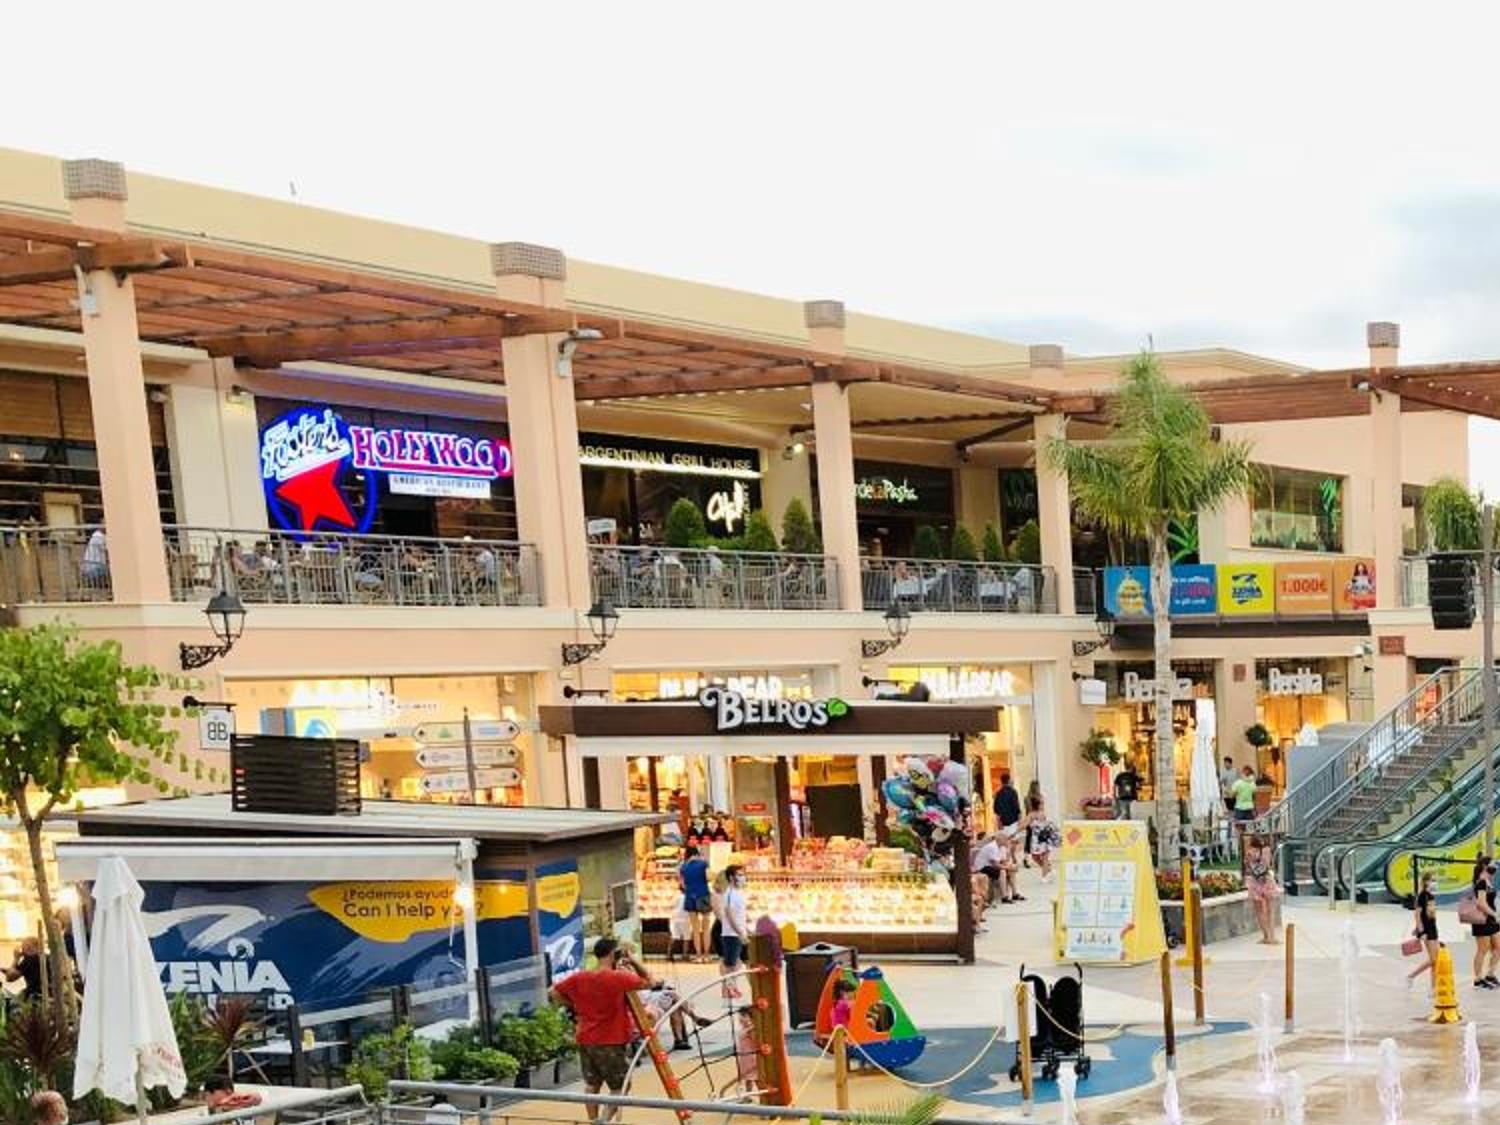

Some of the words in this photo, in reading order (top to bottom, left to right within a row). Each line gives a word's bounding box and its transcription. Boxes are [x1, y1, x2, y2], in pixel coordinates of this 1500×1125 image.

[350, 425, 513, 475] HOLLYWOOD
[672, 454, 706, 468] GRILL
[711, 459, 752, 471] HOUSE
[343, 903, 381, 917] Can
[396, 902, 436, 920] help
